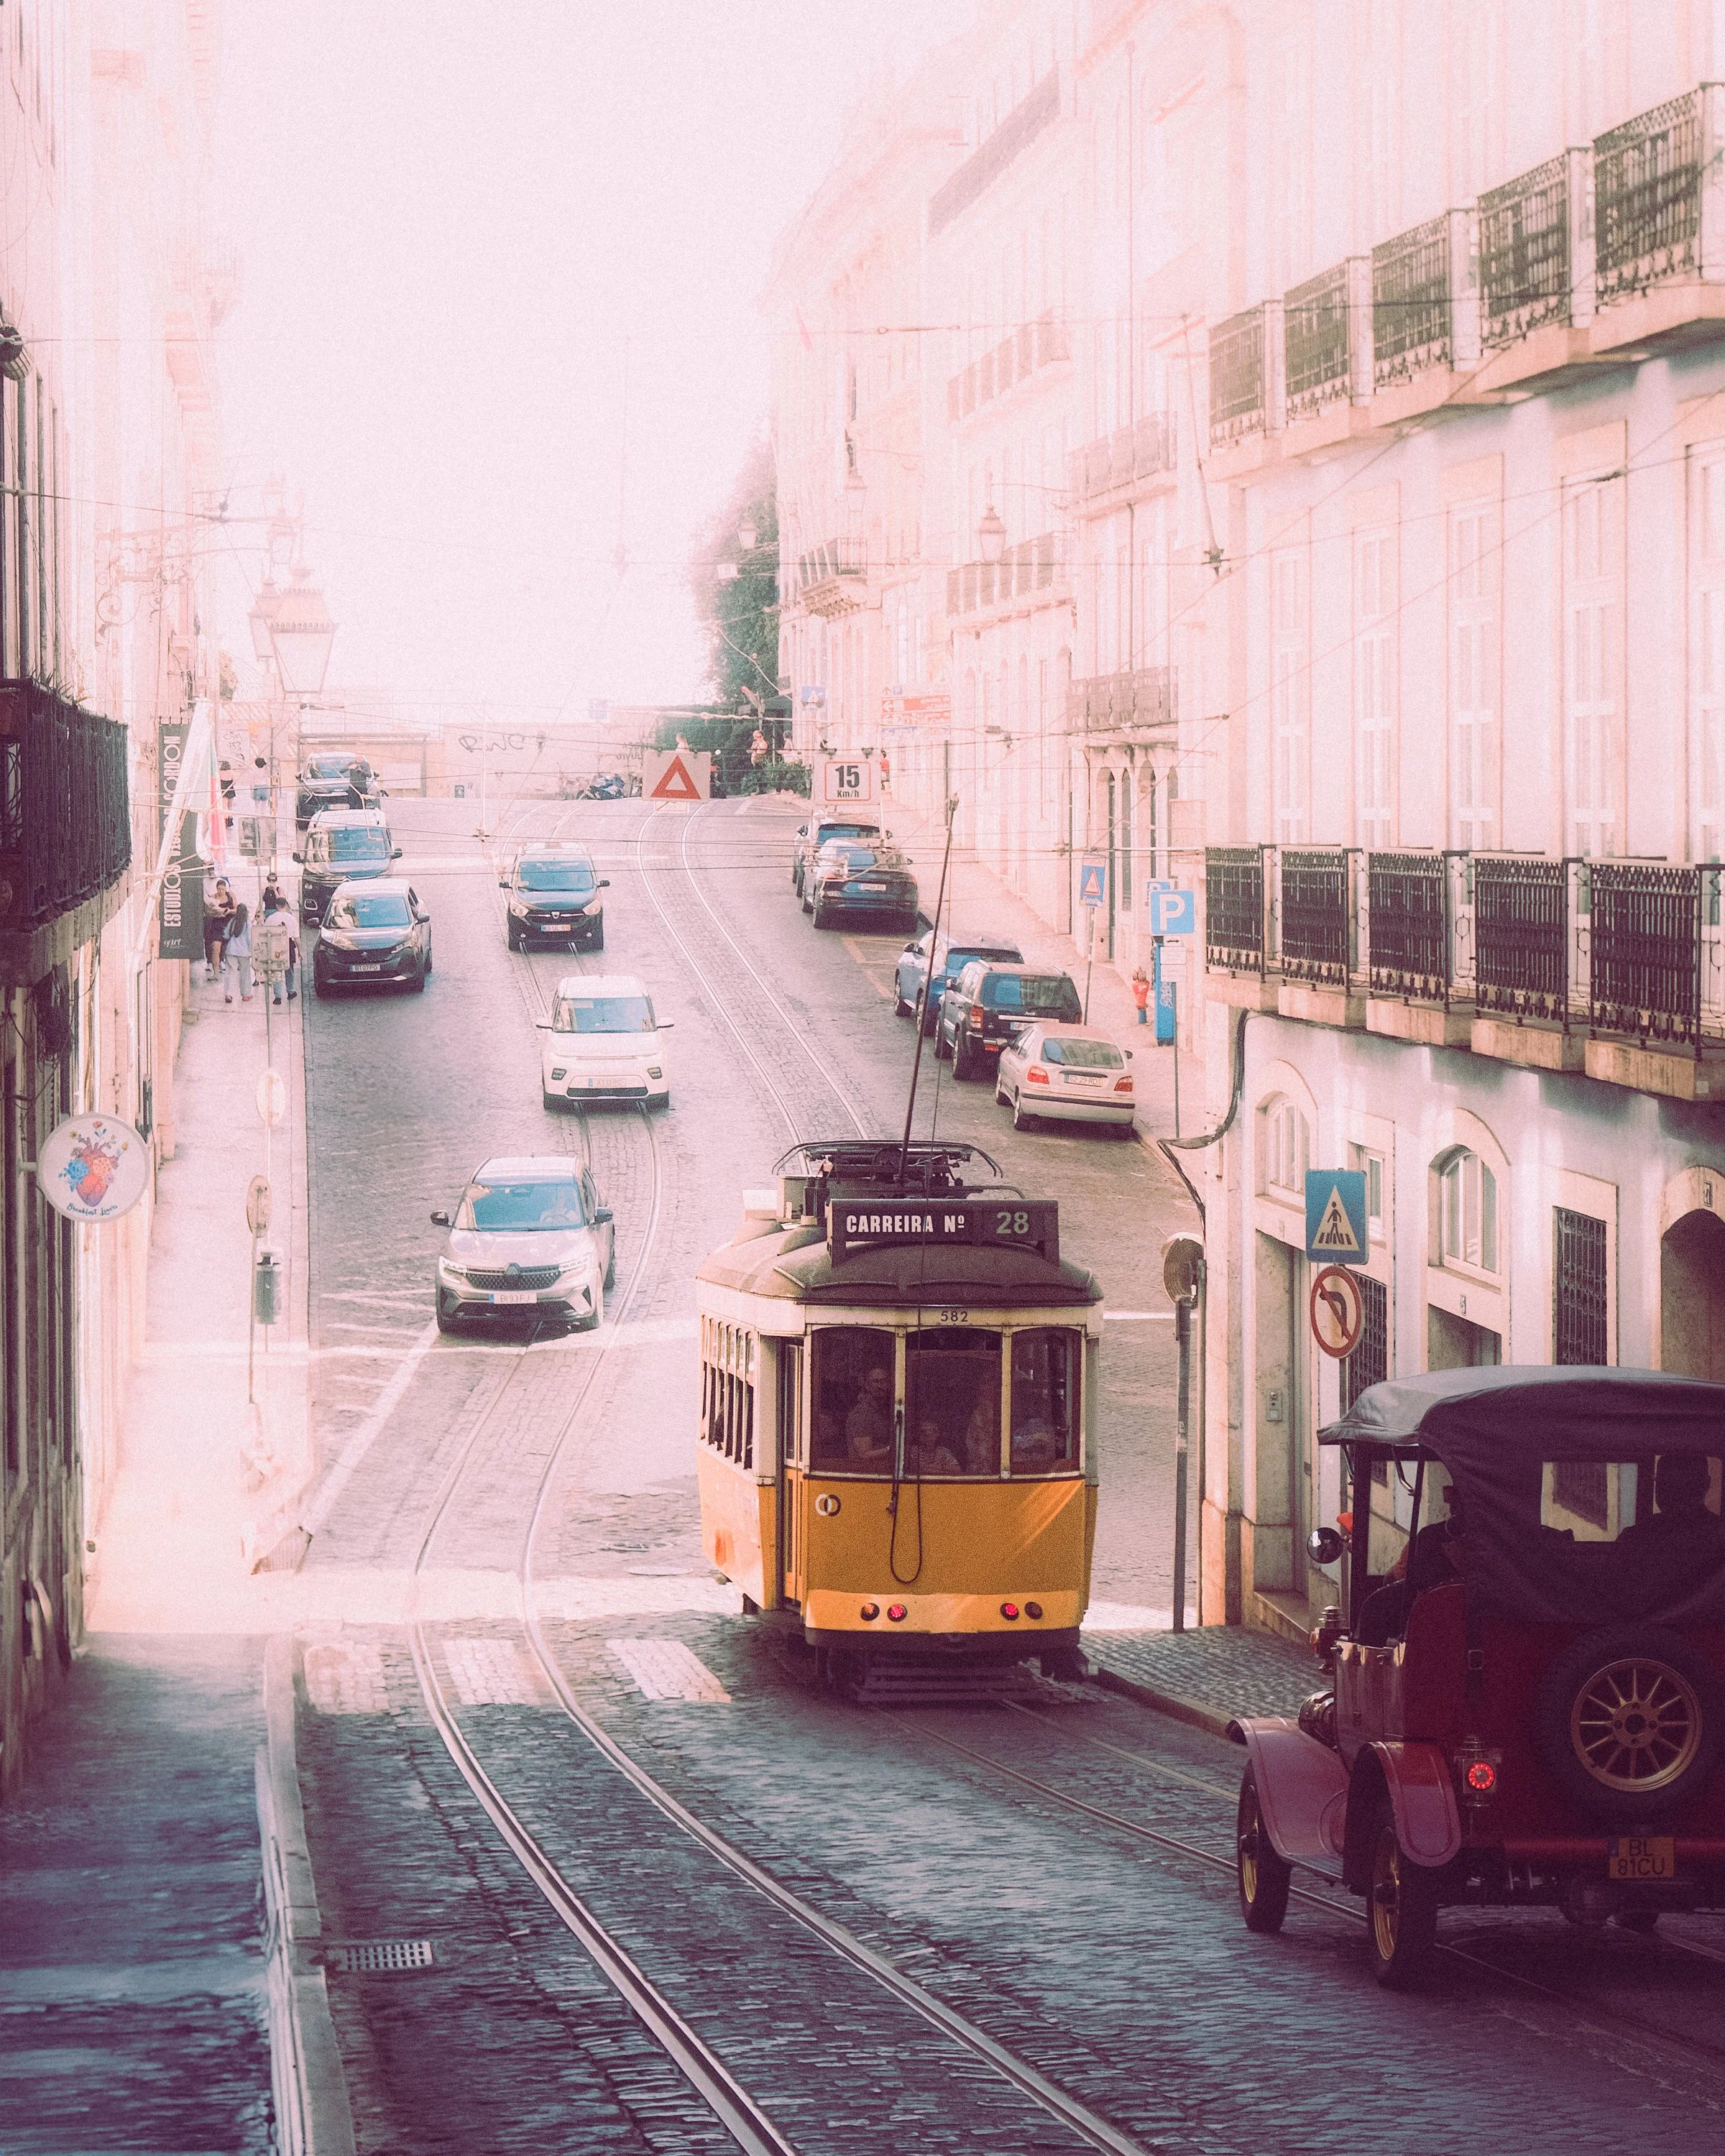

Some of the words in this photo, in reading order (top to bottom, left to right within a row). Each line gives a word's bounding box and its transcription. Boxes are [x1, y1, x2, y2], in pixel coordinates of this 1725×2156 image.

[835, 765, 867, 788] 15
[164, 863, 181, 926] ESTUDIOS
[1159, 894, 1185, 931] P
[846, 1215, 934, 1233] CARREIRA
[996, 1211, 1029, 1234] 28
[941, 1310, 968, 1322] 582
[1629, 1838, 1653, 1856] BL
[1618, 1857, 1665, 1876] 81CU
